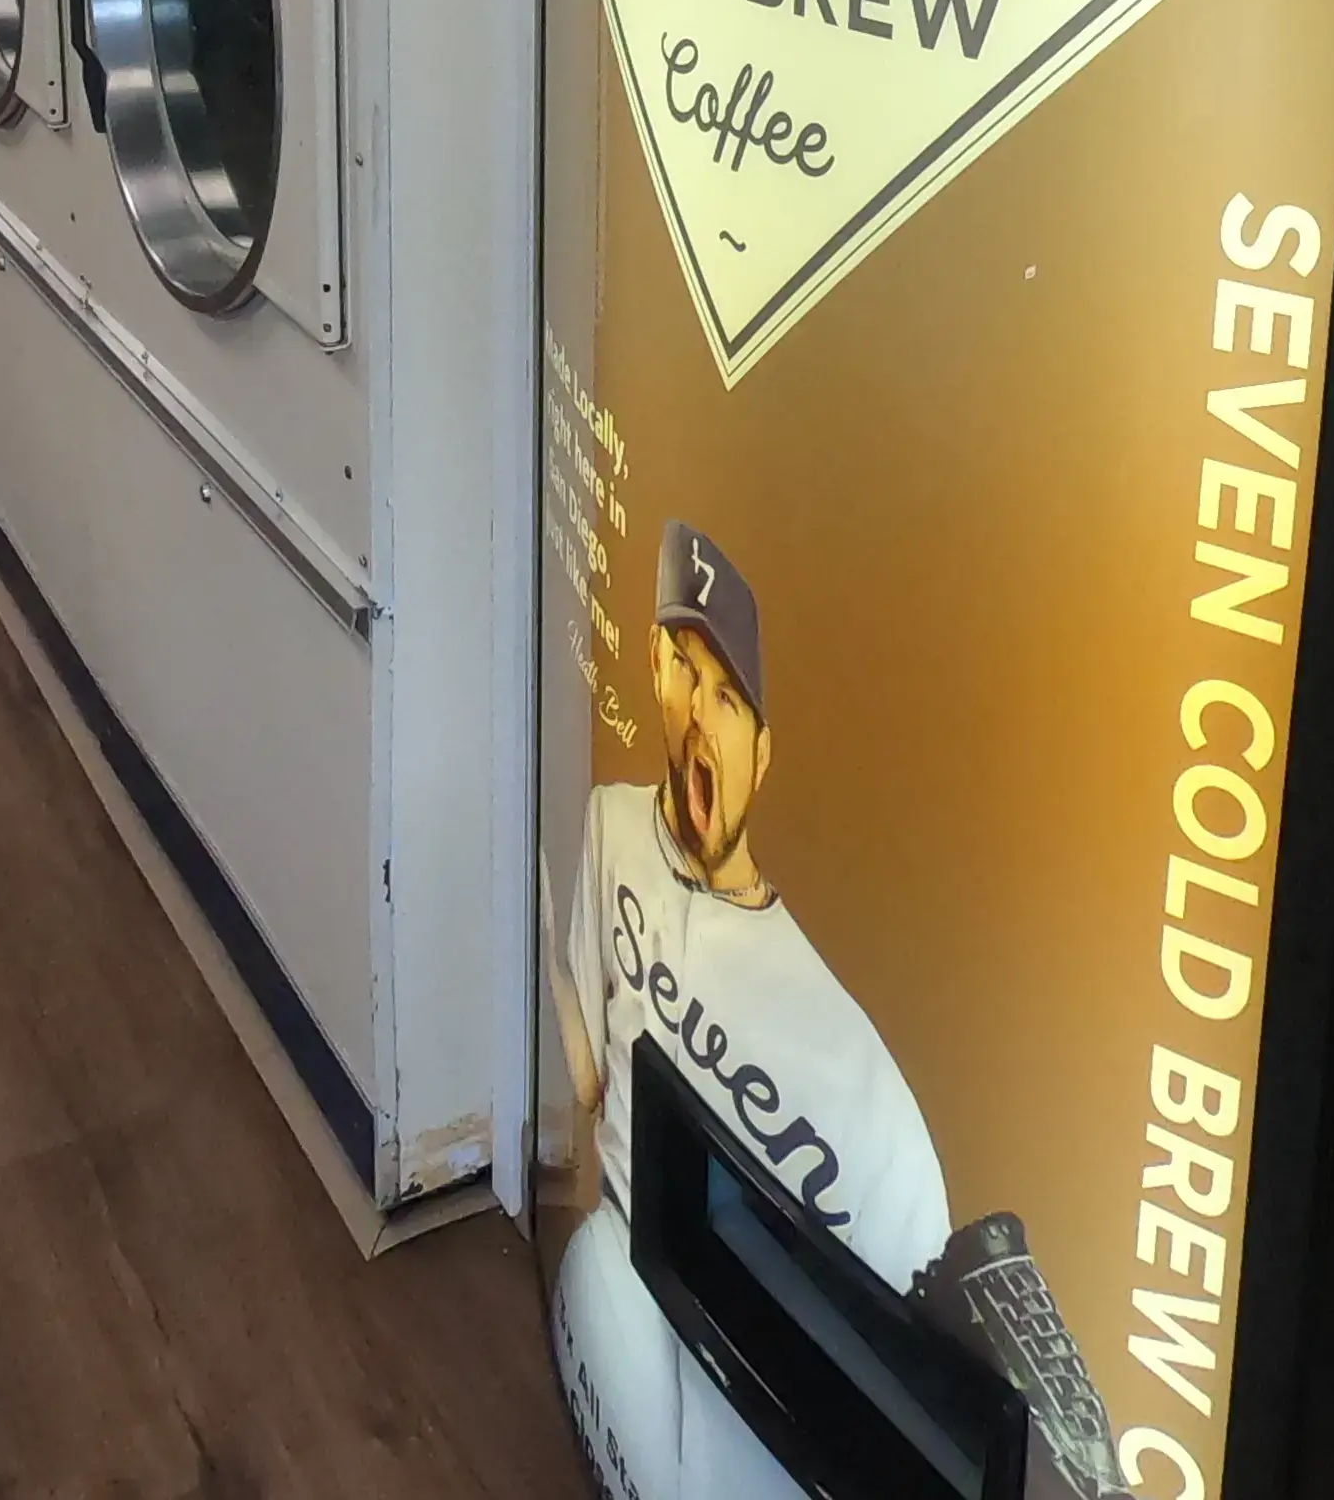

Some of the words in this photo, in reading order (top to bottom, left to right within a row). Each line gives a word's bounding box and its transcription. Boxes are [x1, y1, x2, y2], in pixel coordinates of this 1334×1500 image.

[661, 30, 836, 178] Coffee
[573, 370, 628, 480] Locally,
[1190, 190, 1322, 646] SEVEN
[568, 485, 611, 588] Diego,
[574, 428, 606, 509] here
[609, 481, 627, 539] in
[591, 595, 620, 661] me!
[1162, 677, 1275, 1021] COLD
[612, 883, 852, 1228] Seven
[1127, 1043, 1244, 1419] BREW
[605, 1425, 642, 1500] Sta
